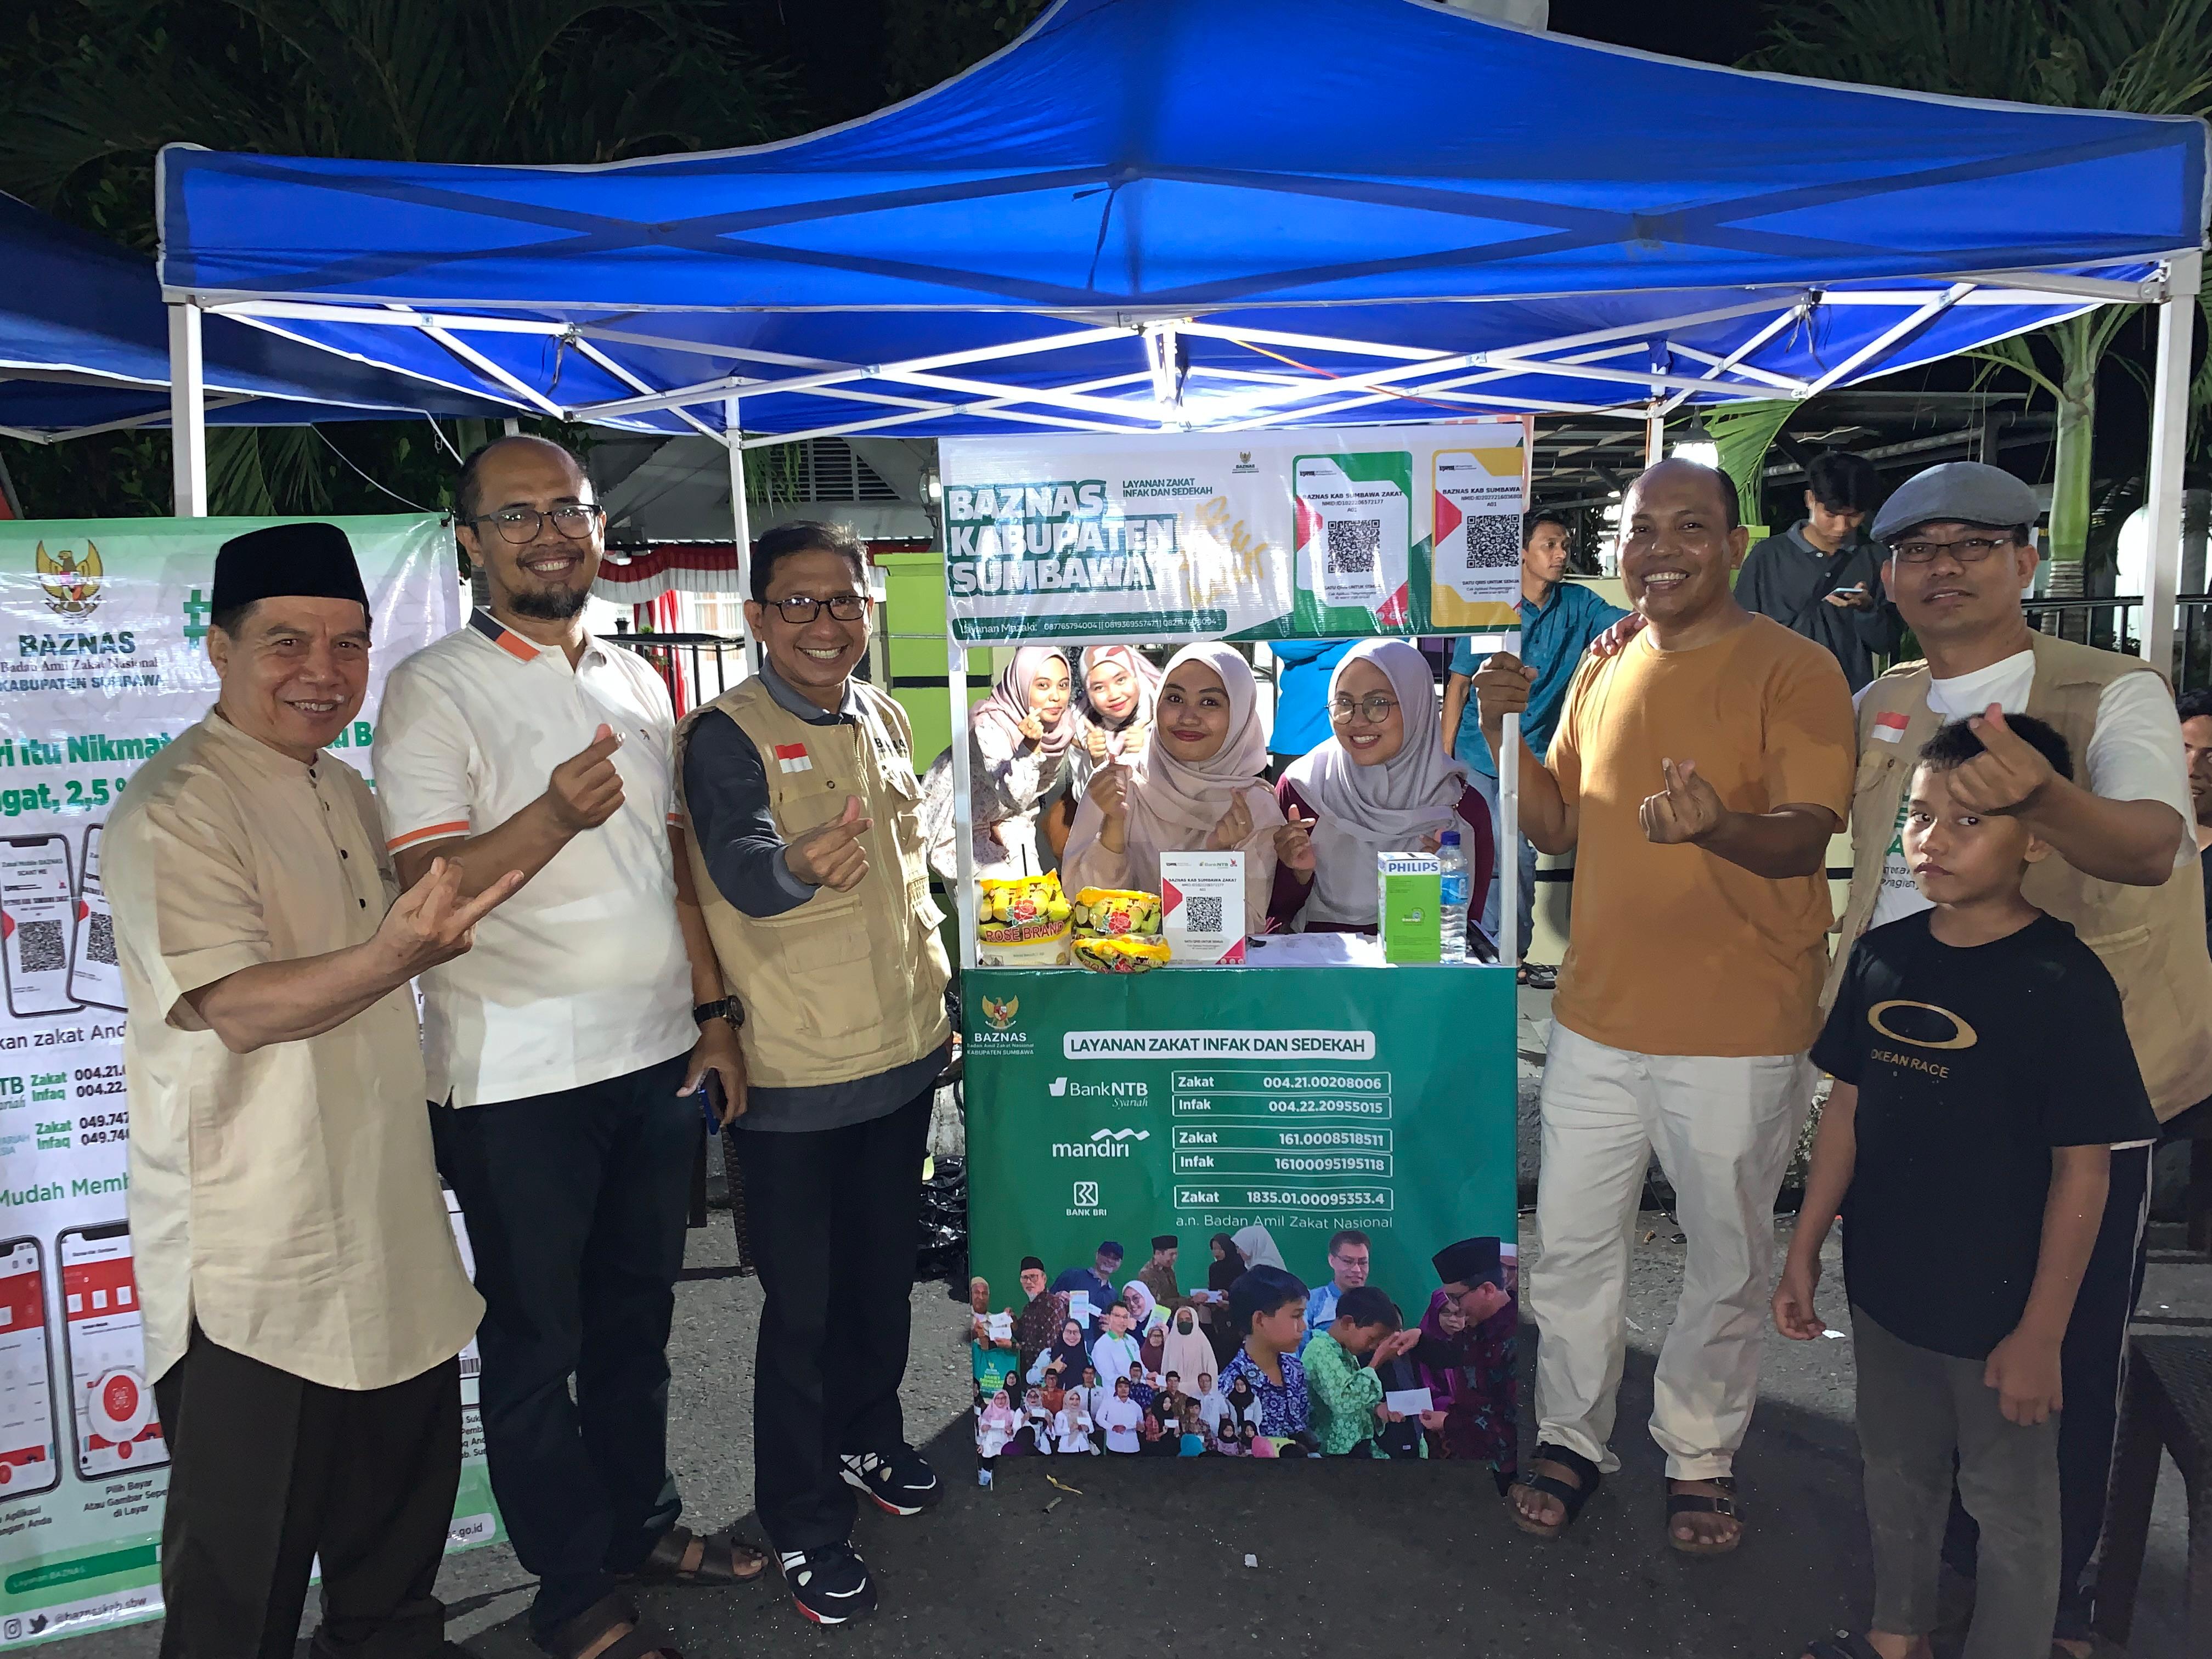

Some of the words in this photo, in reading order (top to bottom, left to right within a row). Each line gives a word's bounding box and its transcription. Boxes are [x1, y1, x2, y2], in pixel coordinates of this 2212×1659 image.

[1122, 478, 1165, 488] LAYANAN
[1166, 478, 1195, 487] ZAKAT
[1123, 489, 1149, 497] INFAK
[1151, 488, 1170, 496] DAN
[1171, 486, 1212, 496] SEDEKAH
[949, 484, 1104, 521] BAZNAS
[950, 518, 1175, 557] KABUPATEN
[952, 553, 1151, 593] SUMBAWA
[1044, 622, 1097, 630] 087765794004
[19, 631, 137, 657] BAZNAS
[21, 738, 61, 766] Itu
[1389, 862, 1438, 872] PHILIPS
[985, 927, 1021, 942] ROSE
[1022, 921, 1065, 940] BRAND
[33, 1027, 84, 1047] zakat
[974, 1032, 1026, 1042] BAZNAS
[1071, 1039, 1146, 1052] LAYANAN
[1149, 1037, 1200, 1051] ZAKAT
[1203, 1038, 1250, 1051] INFAK
[1254, 1038, 1288, 1052] DAN
[1291, 1038, 1365, 1052] SEDEKAH
[1910, 1058, 1950, 1079] RACE
[30, 1071, 67, 1087] Zakat
[1178, 1076, 1215, 1087] Zakat
[1263, 1076, 1382, 1090] 004.21.00208006
[32, 1088, 66, 1102] Infaq
[1070, 1081, 1148, 1096] BankNTB
[1112, 1097, 1148, 1109] Syariah
[1179, 1098, 1211, 1110] Infak
[1268, 1100, 1383, 1114] 004.22.20955015
[35, 1120, 72, 1135] Zakat
[37, 1136, 71, 1150] Infaq
[1179, 1131, 1218, 1144] Zakat
[1279, 1132, 1384, 1147] 161.0008518511
[1052, 1139, 1129, 1157] mandiri
[1180, 1155, 1215, 1167] Infak
[1274, 1158, 1385, 1171] 16100095195118
[1181, 1191, 1220, 1203] Zakat
[1246, 1191, 1385, 1205] 1835.01.00095353.4
[1176, 1216, 1199, 1227] a.n.
[1204, 1214, 1248, 1227] Badan
[1253, 1215, 1284, 1227] Amil
[1290, 1215, 1329, 1229] Zakat
[1334, 1216, 1393, 1229] Nasional
[127, 1480, 153, 1491] Bayar
[106, 1494, 143, 1506] Gambar
[125, 1505, 149, 1516] Layar
